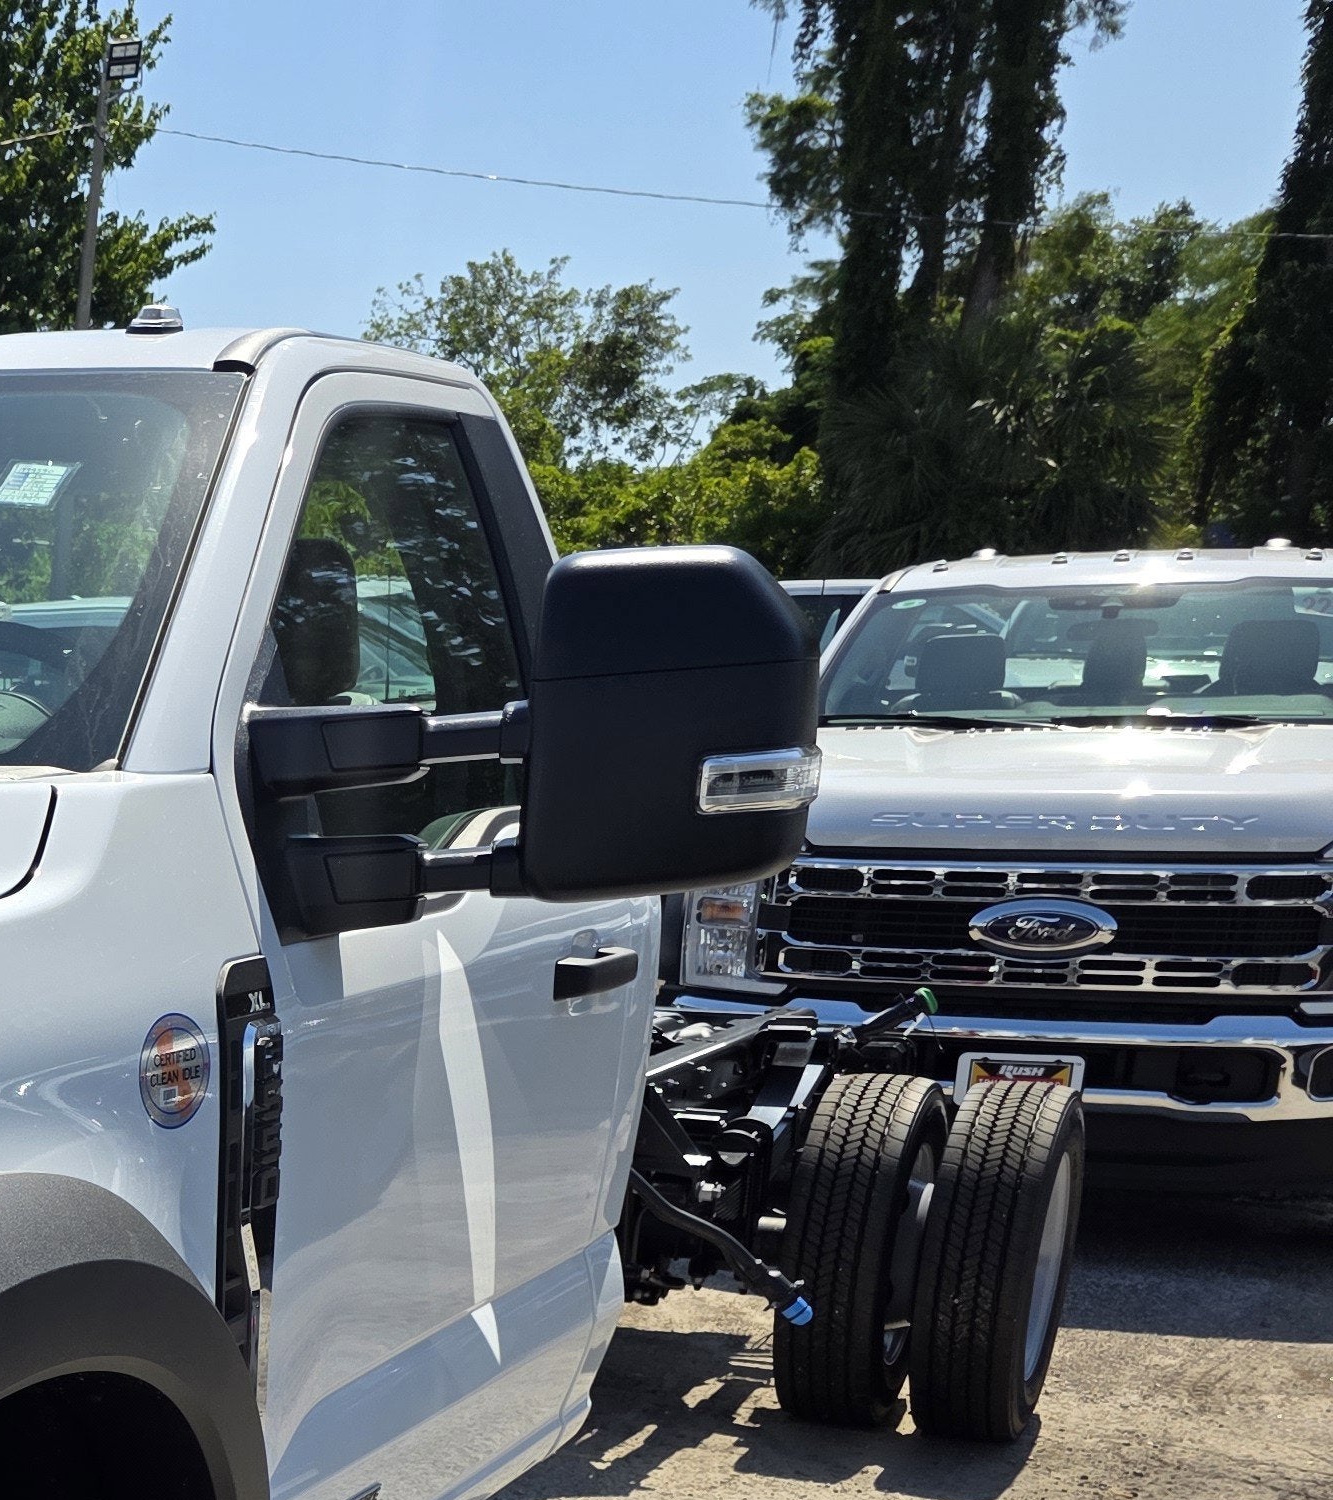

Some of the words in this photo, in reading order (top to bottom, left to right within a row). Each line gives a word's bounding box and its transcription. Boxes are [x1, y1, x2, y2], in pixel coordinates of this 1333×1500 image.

[870, 811, 1076, 831] SUPER
[1091, 812, 1260, 831] DUTY
[1007, 915, 1076, 940] Ford
[248, 990, 271, 1013] XL
[153, 1048, 197, 1068] CERTIFIED
[149, 1071, 179, 1088] CLEAN
[183, 1065, 201, 1081] IDLE
[998, 1064, 1046, 1079] RUSH
